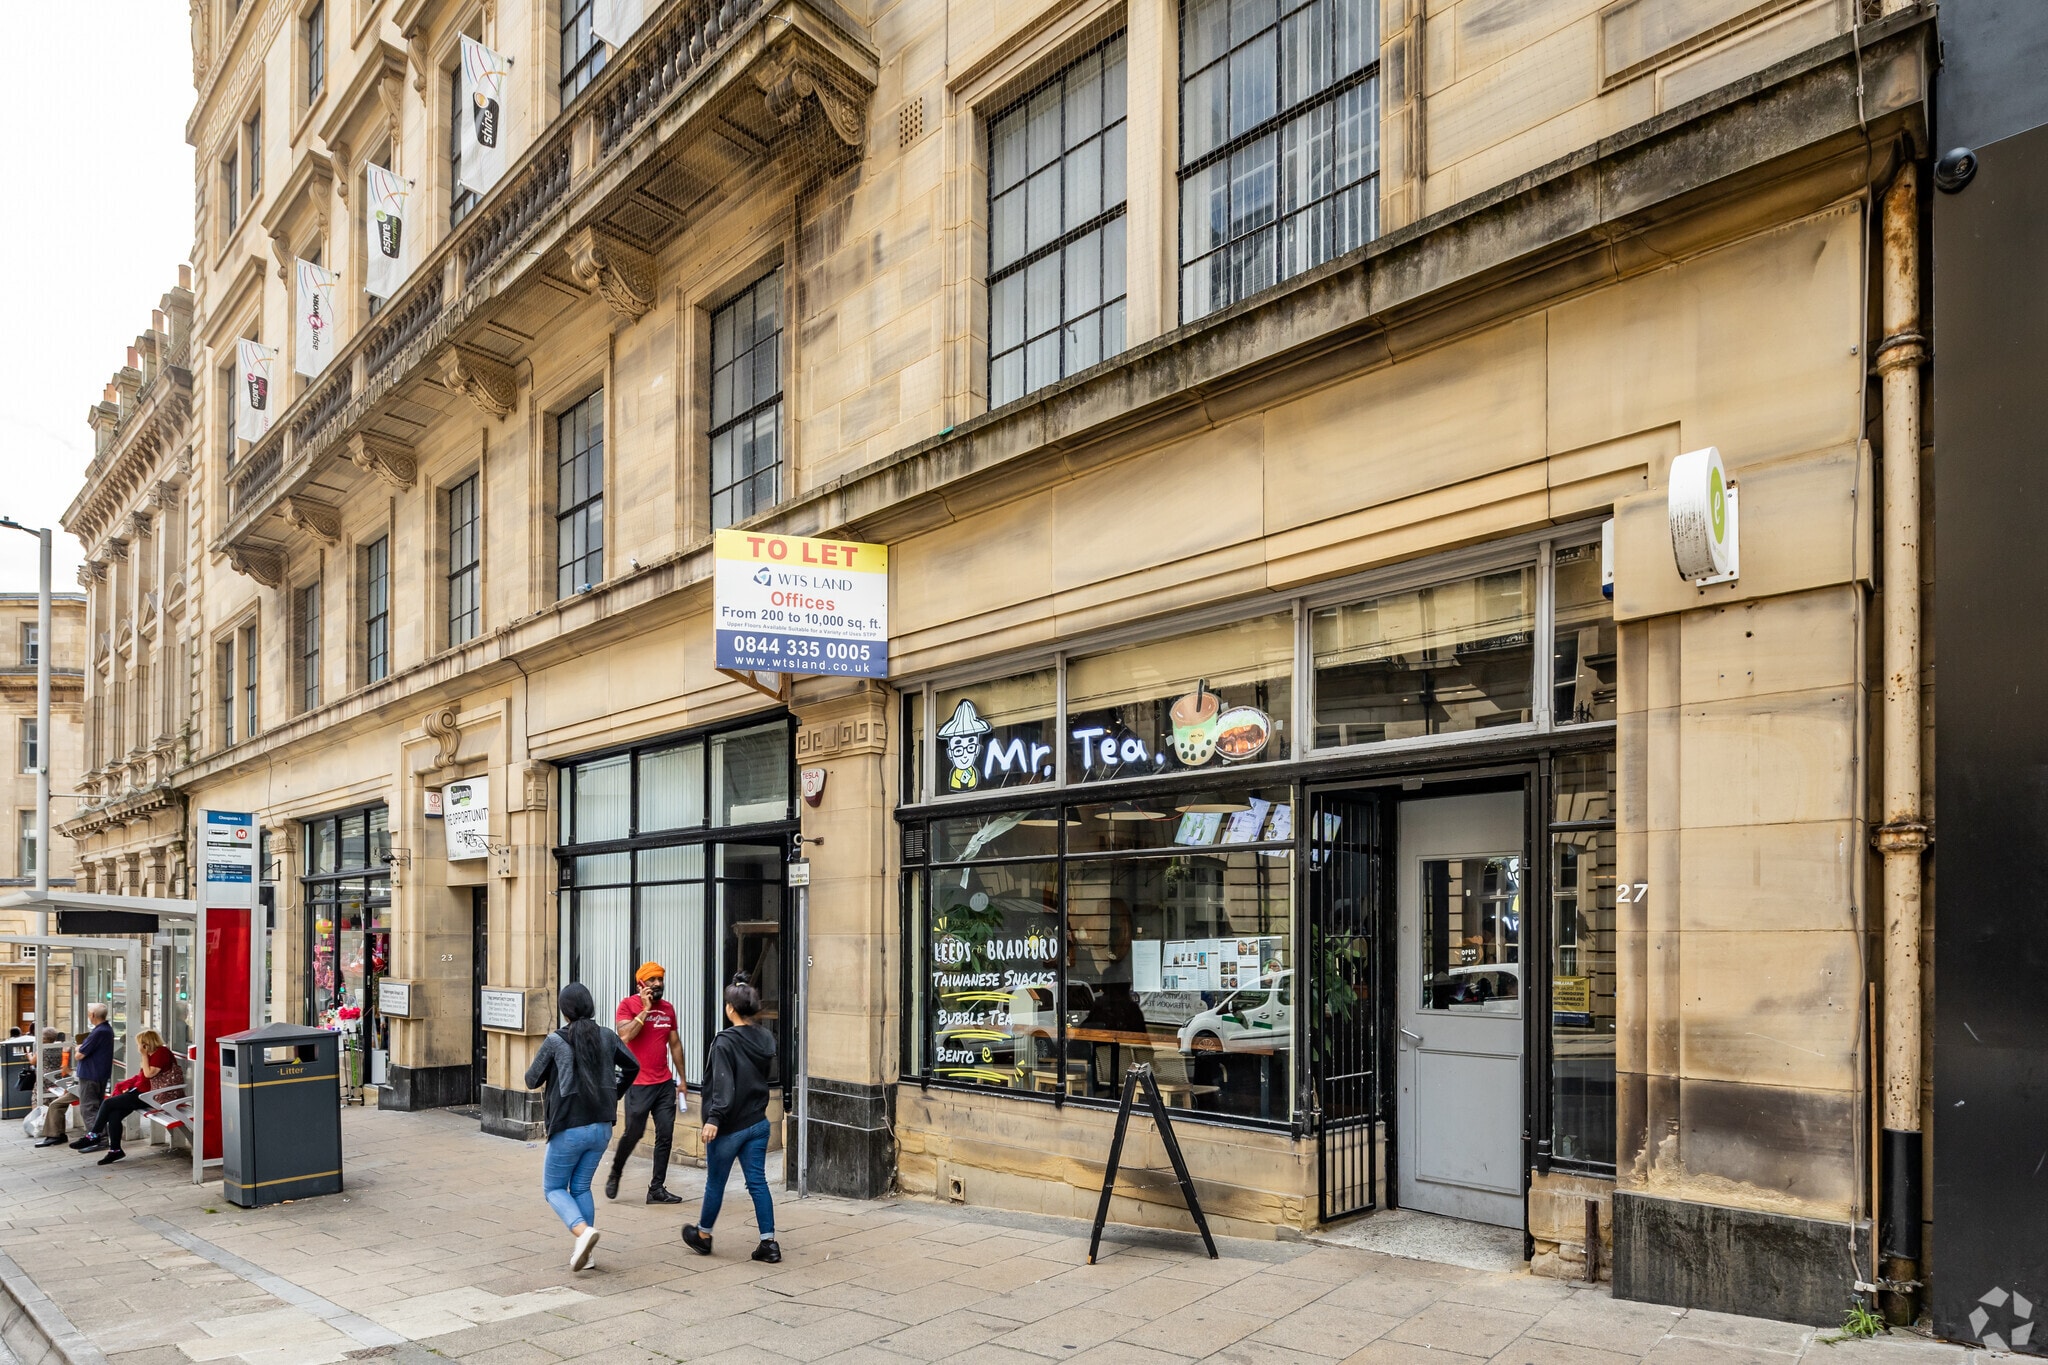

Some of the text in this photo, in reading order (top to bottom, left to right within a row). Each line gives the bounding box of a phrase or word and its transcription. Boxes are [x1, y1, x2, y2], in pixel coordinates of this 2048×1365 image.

[483, 109, 494, 145] shine
[382, 223, 391, 254] aspire
[400, 351, 411, 376] OF
[251, 383, 259, 408] aspire
[746, 536, 858, 567] TO LET
[778, 572, 853, 591] WTS LAND
[770, 591, 835, 611] Offices
[722, 606, 882, 630] From 200 to 10,000 sq. ft.
[726, 621, 743, 629] Upper
[744, 621, 762, 629] Floors
[823, 629, 842, 637] Variety
[734, 635, 871, 661] 0844 335 0005
[734, 655, 870, 673] www.wtsland.co.uk
[984, 727, 1166, 780] Mr. Tea.
[803, 771, 819, 780] TESLA
[1616, 883, 1648, 904] 27
[934, 939, 971, 963] LEEDS
[986, 938, 1058, 961] BRADFORD
[932, 970, 1057, 988] TAIWANESE SNACKS
[937, 1010, 1013, 1026] BUBBLE TEA
[936, 1047, 975, 1064] BENTO
[279, 1067, 304, 1076] Litter
